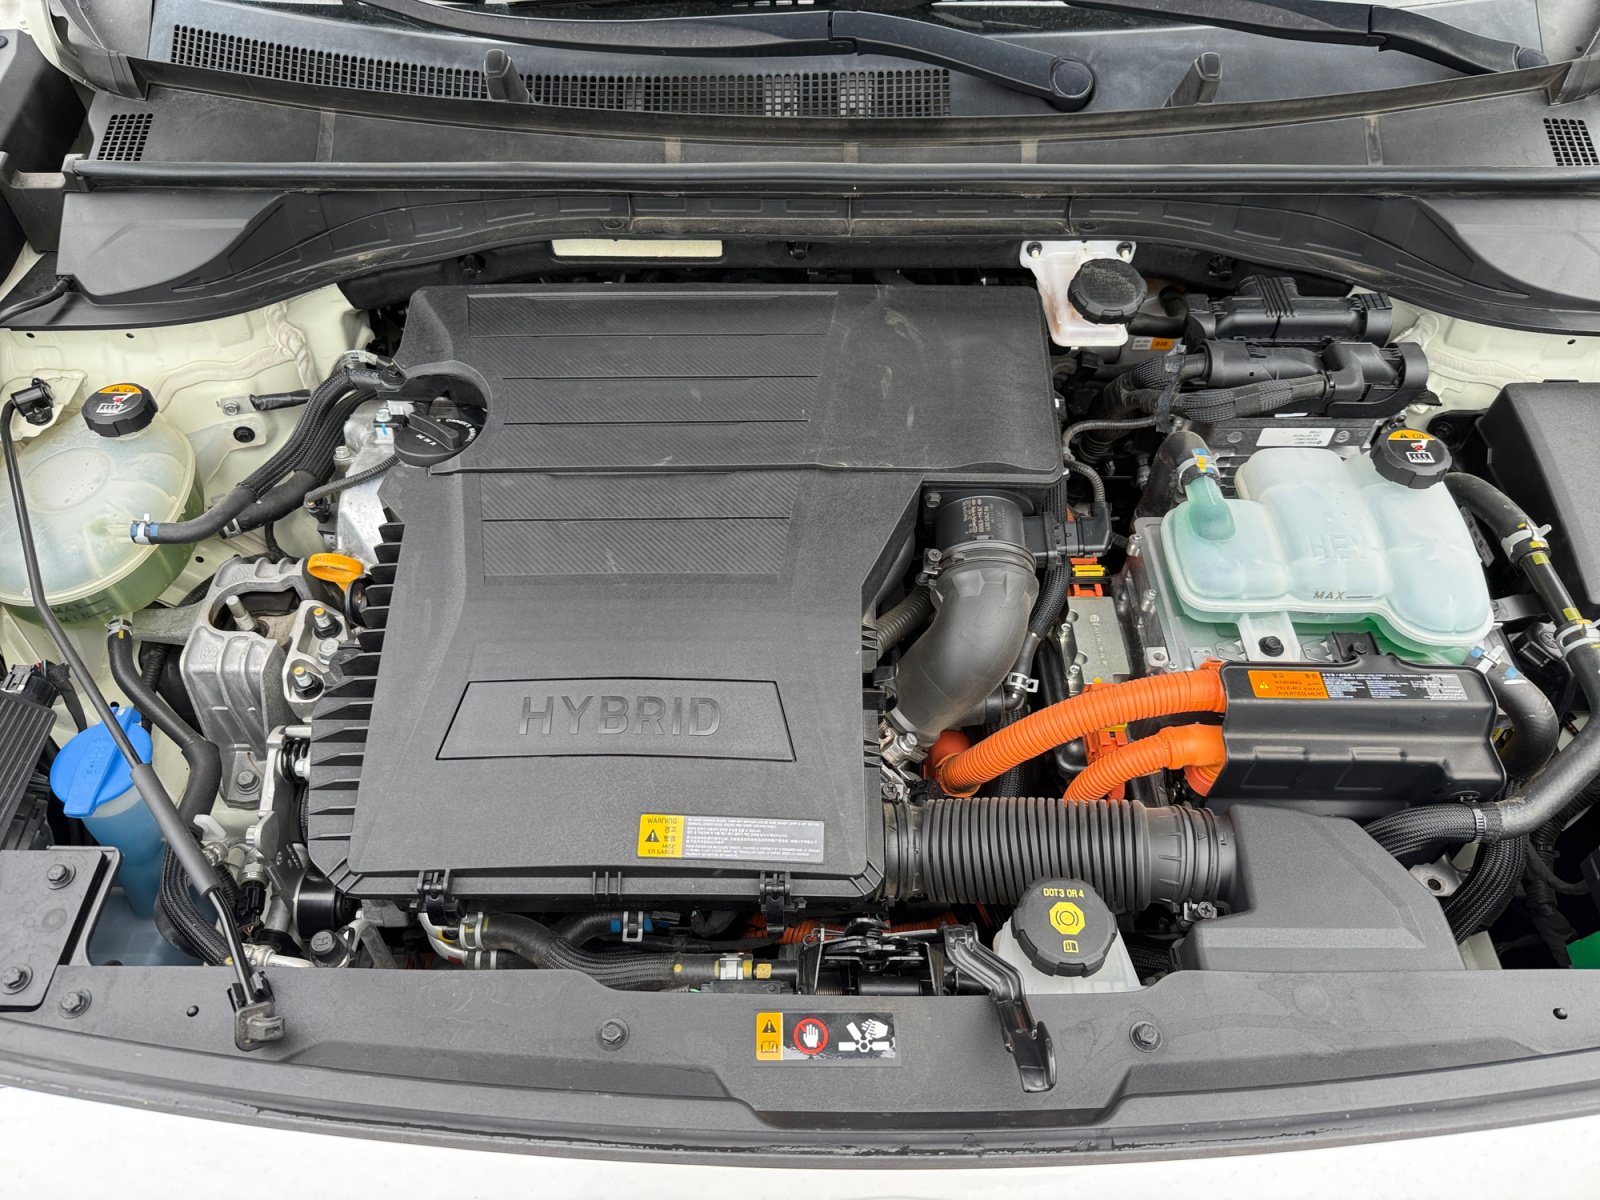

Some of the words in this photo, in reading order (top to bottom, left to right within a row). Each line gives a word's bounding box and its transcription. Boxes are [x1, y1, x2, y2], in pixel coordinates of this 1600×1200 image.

[1312, 590, 1345, 600] MAX
[518, 695, 721, 737] HYBRID
[647, 817, 678, 825] WARNING
[1066, 888, 1078, 898] OR
[1079, 889, 1084, 898] 4
